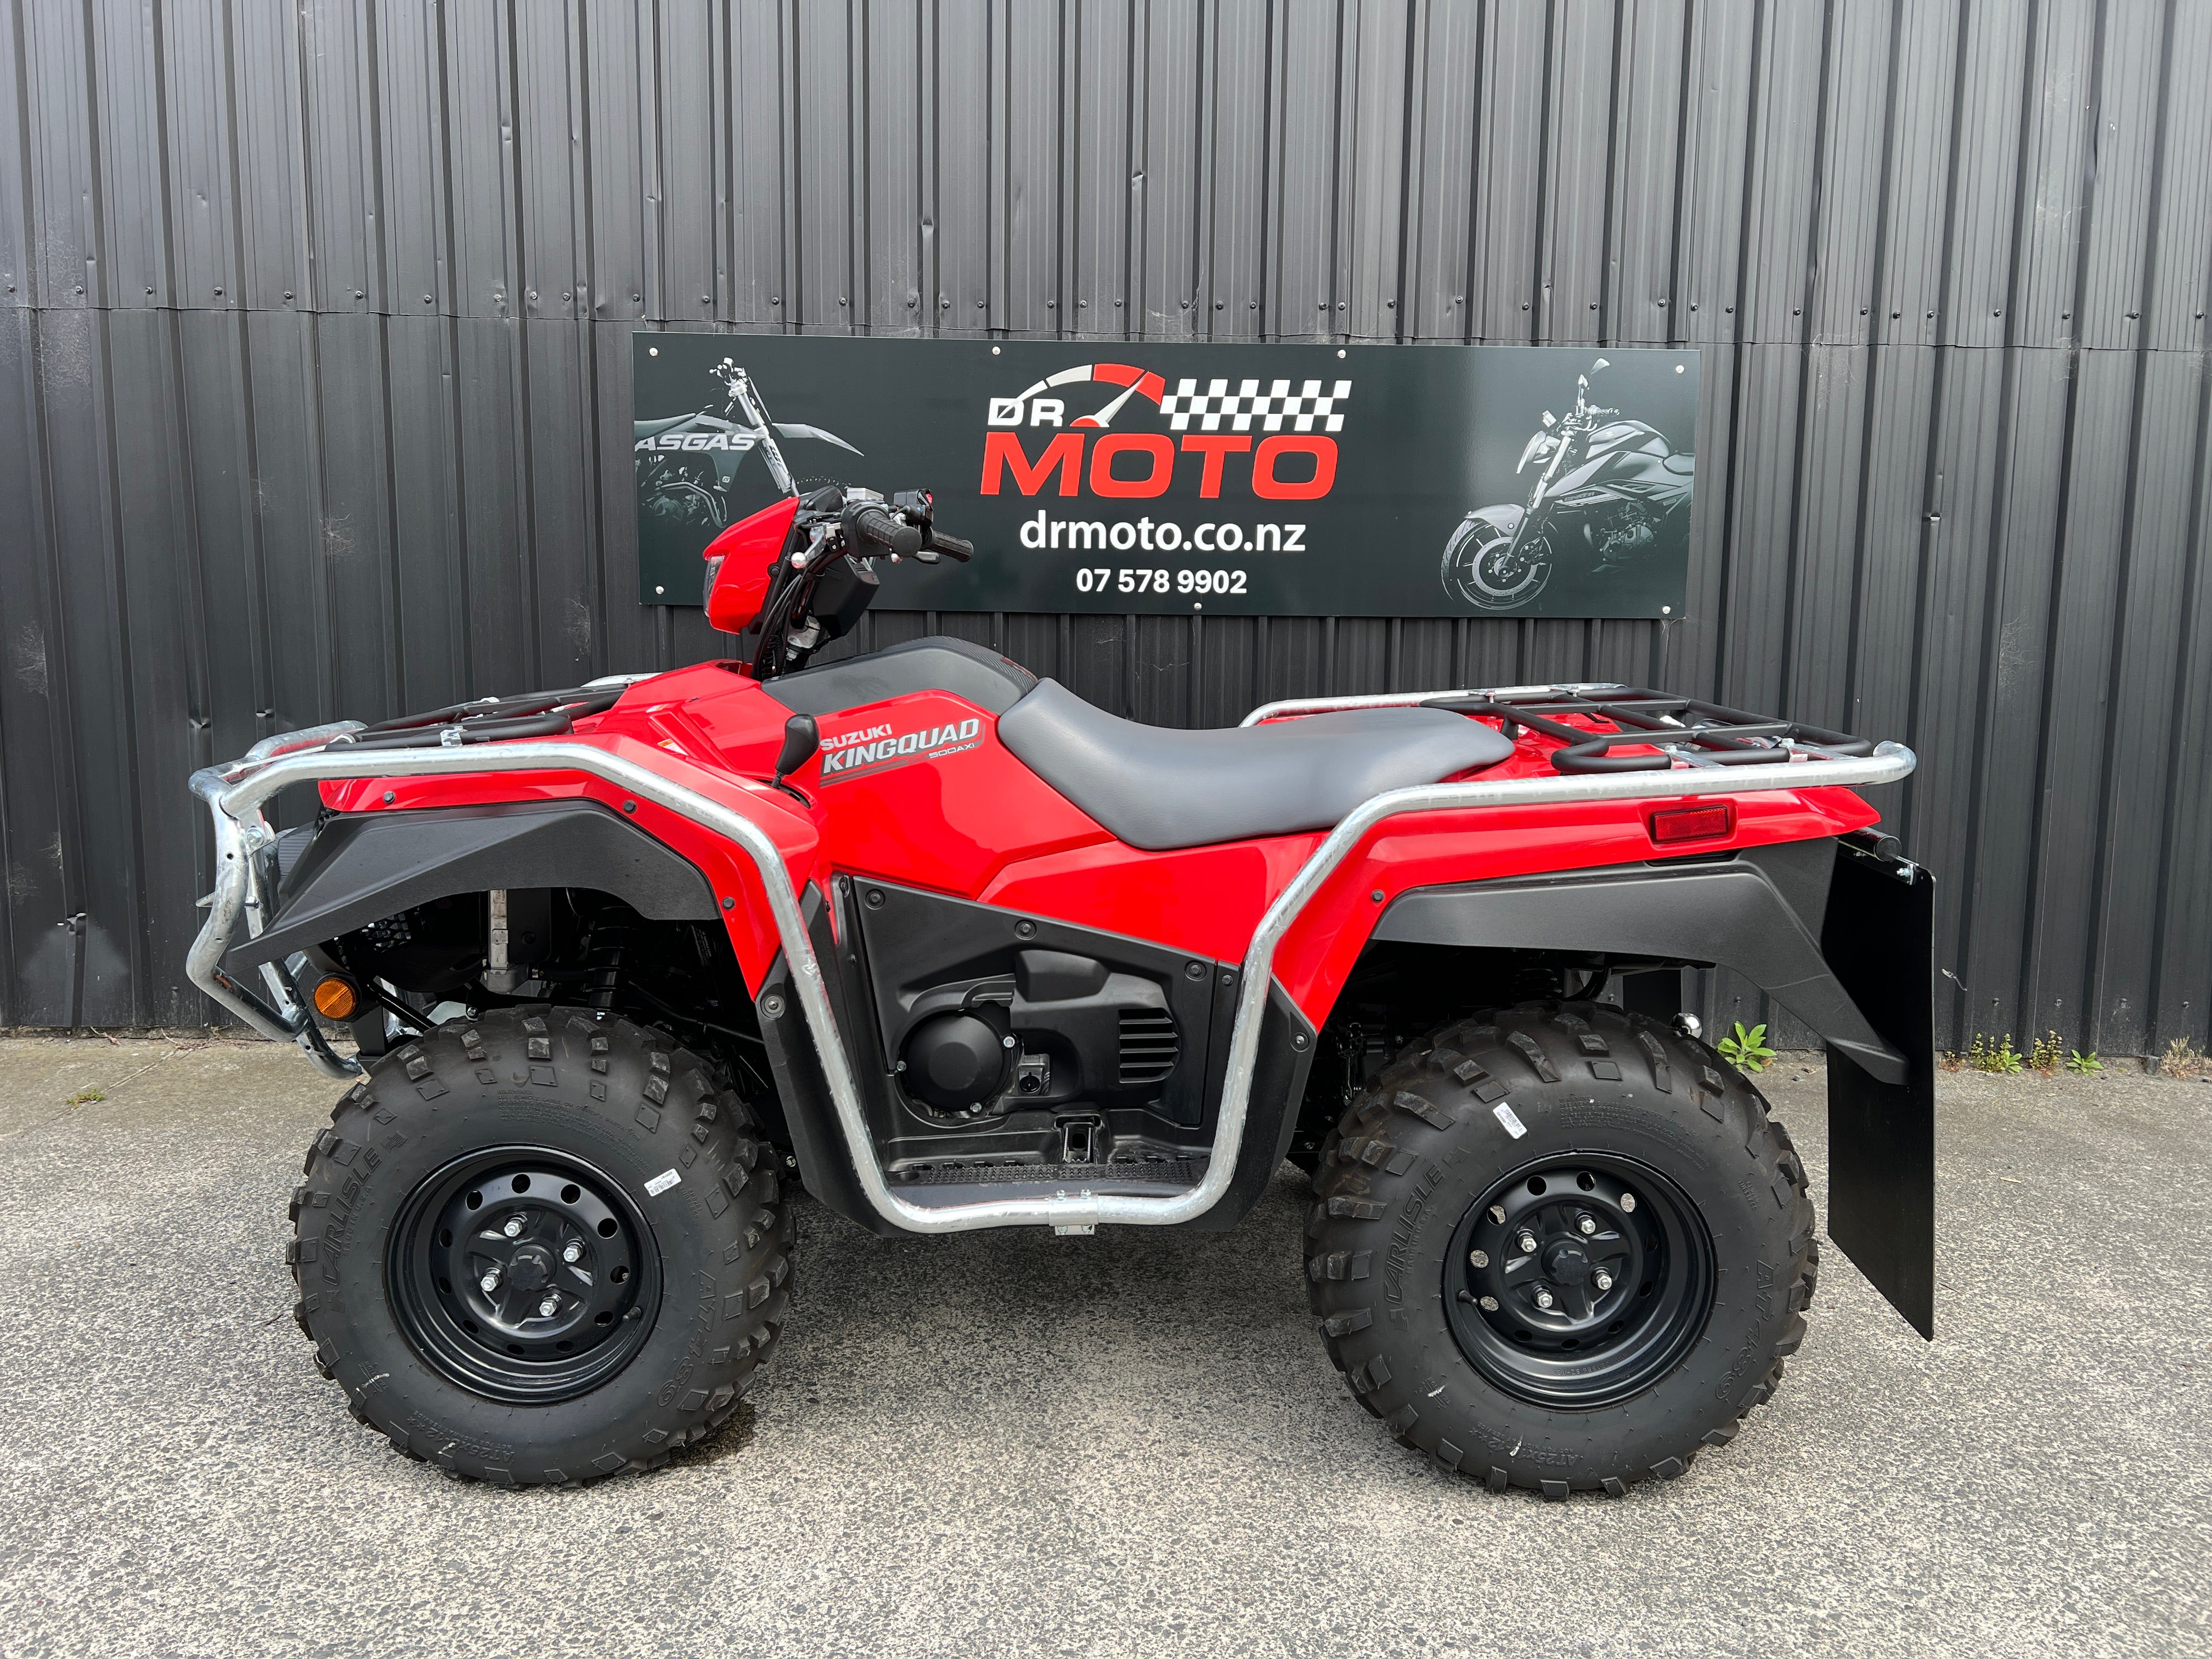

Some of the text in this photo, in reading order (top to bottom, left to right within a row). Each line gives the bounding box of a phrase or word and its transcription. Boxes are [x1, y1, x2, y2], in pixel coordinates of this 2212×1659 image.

[988, 397, 1065, 427] DR
[634, 433, 757, 452] ASGAS
[980, 431, 1339, 500] MOTO
[1020, 509, 1307, 551] drmoto.co.nz
[1076, 568, 1248, 594] 07 578 9902
[819, 723, 893, 751] SUZUKI
[822, 718, 980, 775] KINGQUAD
[321, 1146, 383, 1286] CARLISLE
[1384, 1162, 1445, 1305] CARLISLE
